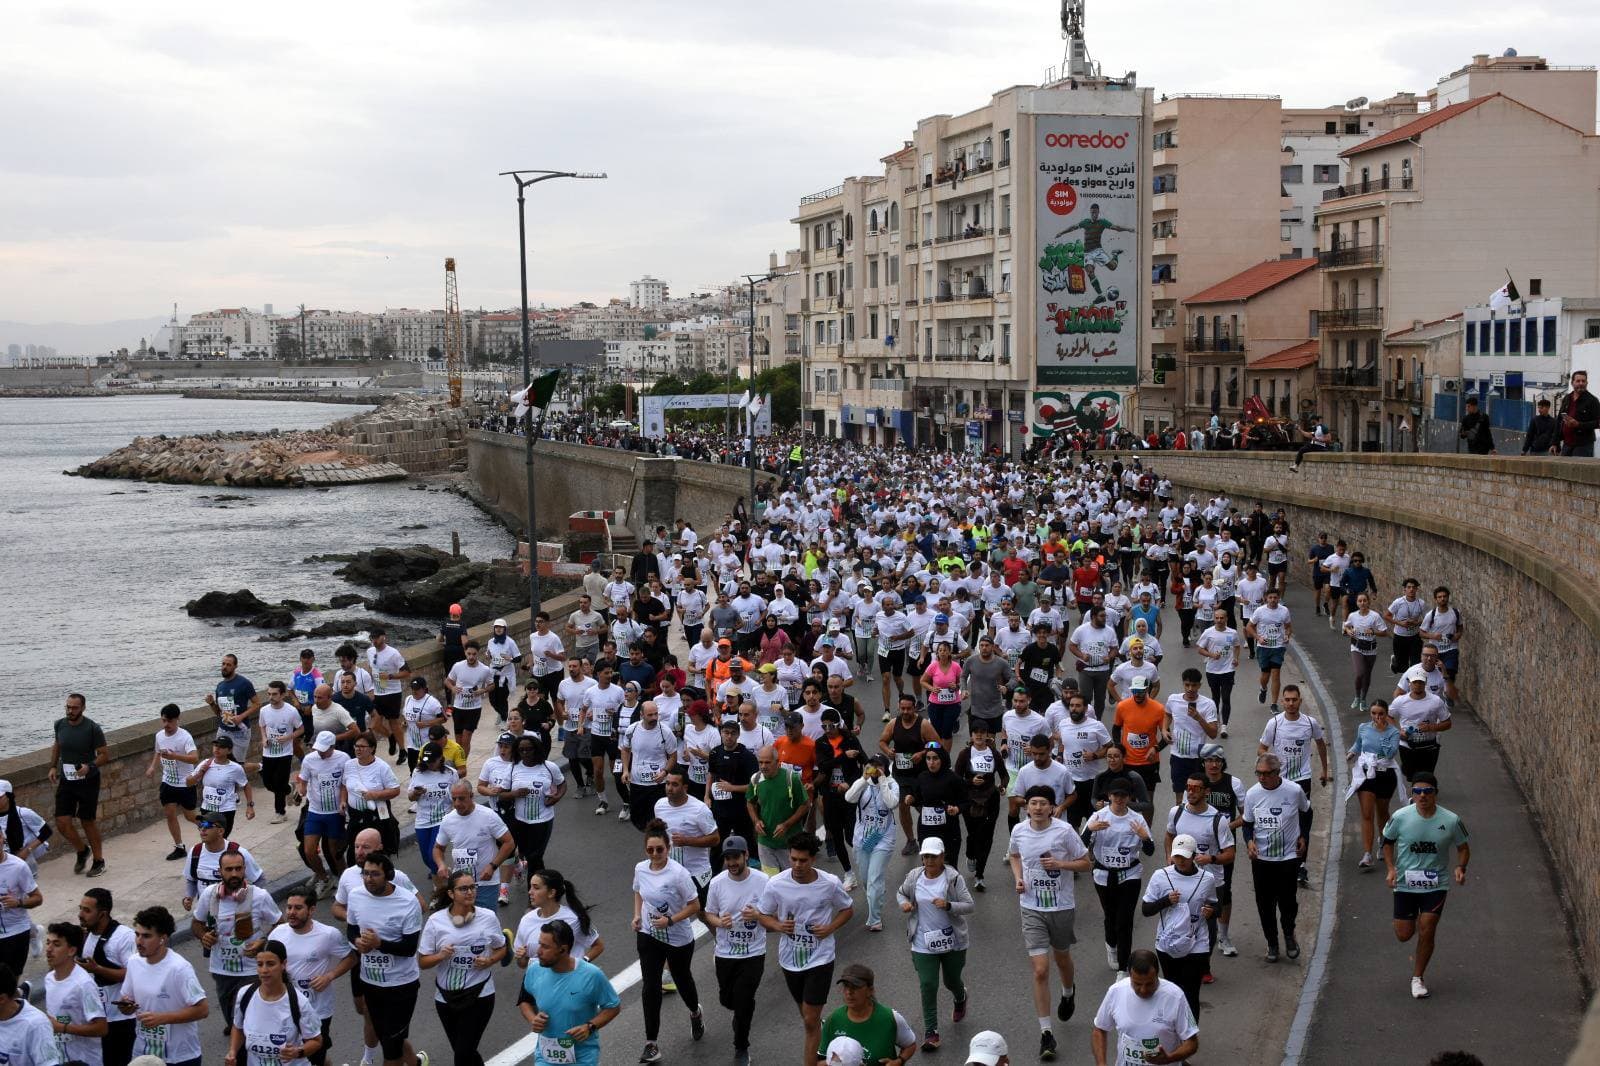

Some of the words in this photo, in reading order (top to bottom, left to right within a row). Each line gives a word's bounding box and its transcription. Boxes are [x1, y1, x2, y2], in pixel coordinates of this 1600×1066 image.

[1045, 130, 1128, 149] ooredoo
[1040, 162, 1082, 174] مولودية
[1084, 163, 1102, 172] SIM
[1081, 177, 1107, 188] gigas
[456, 857, 474, 865] 5977
[1105, 855, 1127, 864] 3743
[1033, 878, 1057, 887] 2865
[729, 930, 753, 939] 3439
[930, 937, 953, 949] 4056
[365, 954, 390, 964] 3568
[453, 956, 476, 965] 482
[251, 1044, 280, 1054] 4128
[546, 1049, 566, 1059] 188
